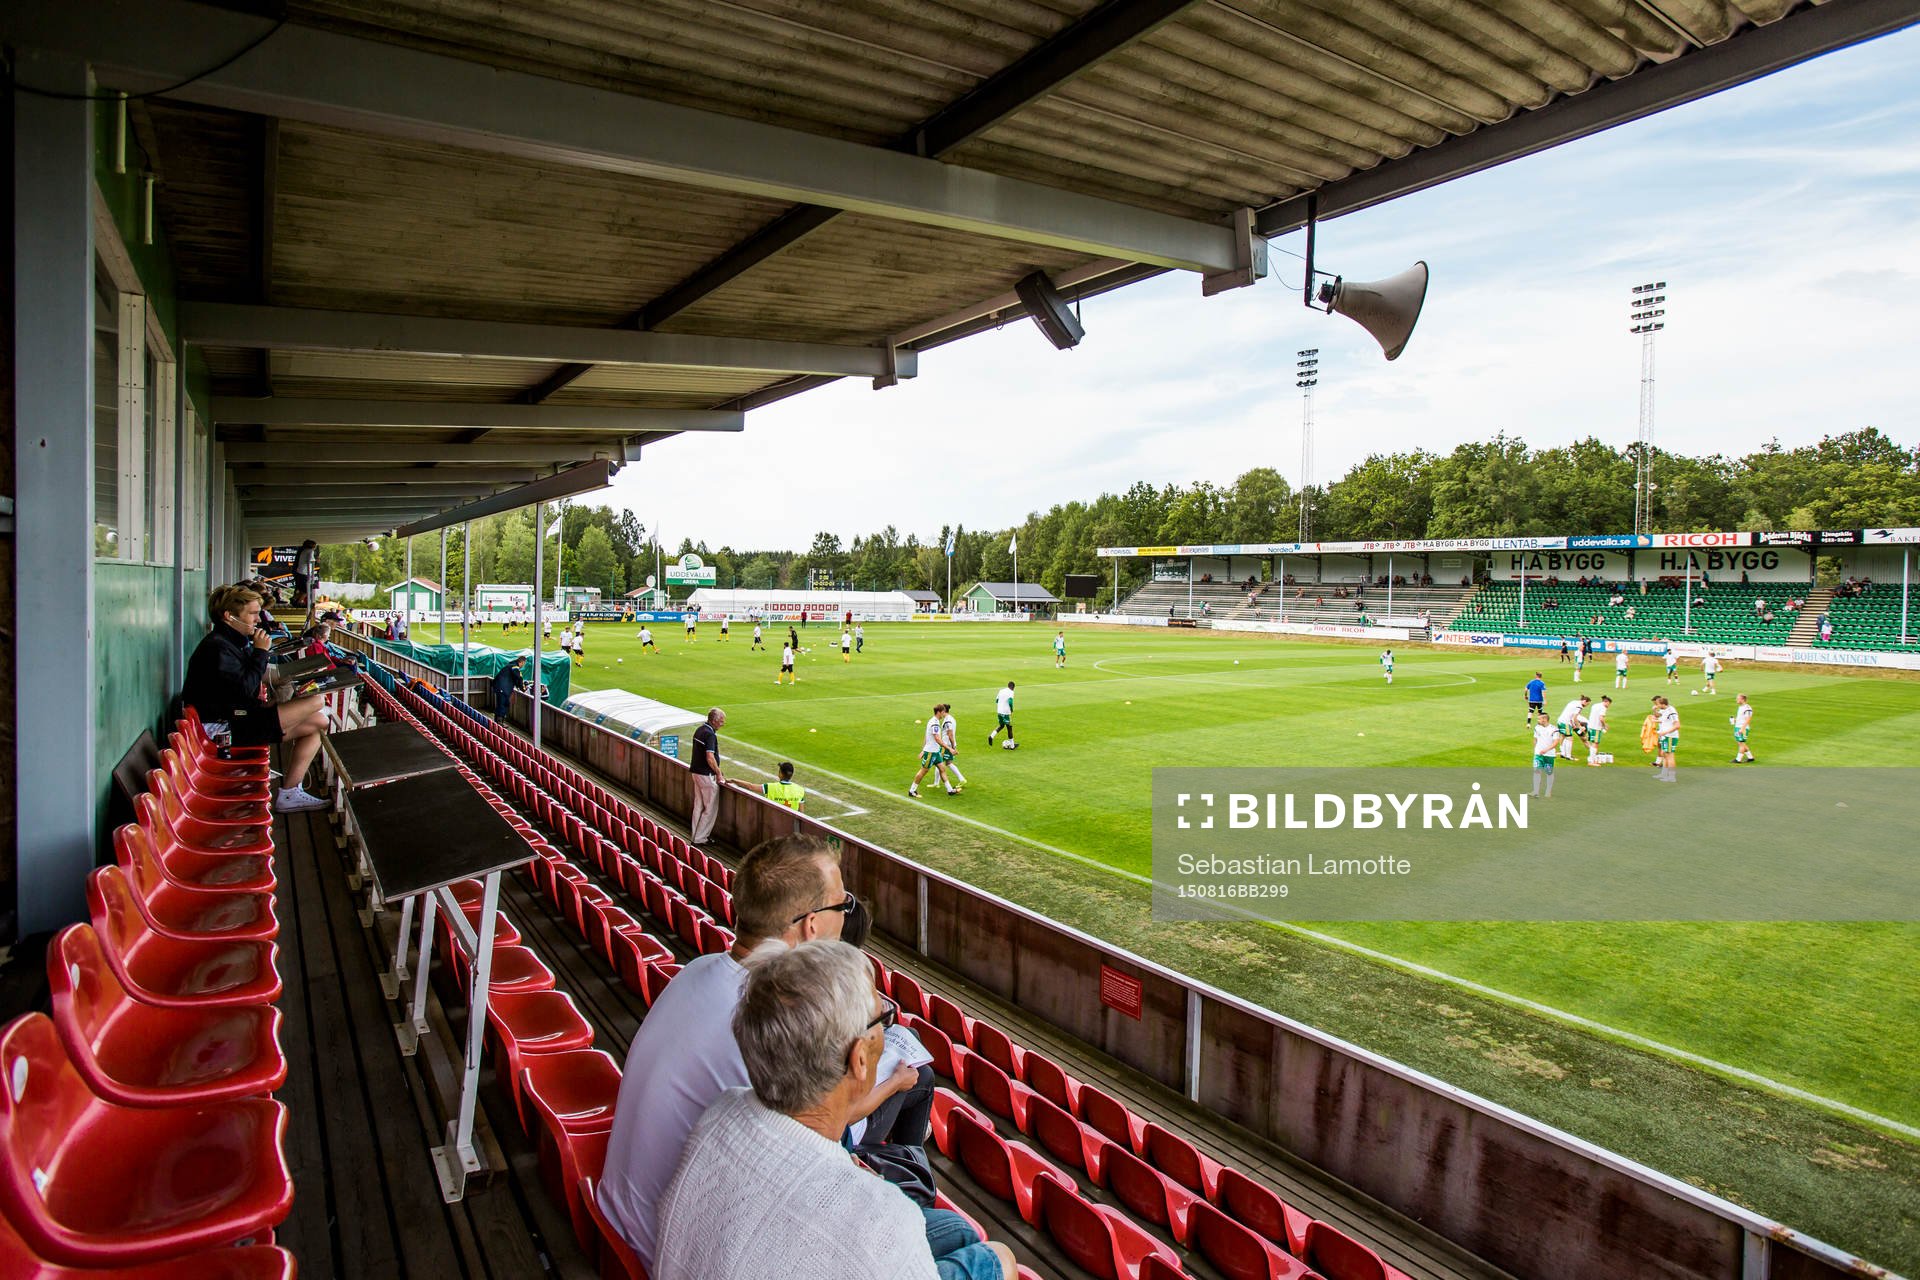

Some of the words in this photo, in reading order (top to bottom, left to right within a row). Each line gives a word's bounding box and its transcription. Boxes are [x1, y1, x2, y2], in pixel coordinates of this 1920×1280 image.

[1491, 539, 1538, 549] LLENTAB
[1572, 538, 1631, 547] uddevalla.se
[1665, 534, 1738, 546] RICOH
[1511, 553, 1543, 570] H.A
[1549, 553, 1605, 570] BYGG
[1661, 552, 1700, 570] H.A
[1708, 551, 1779, 570] BYGG
[360, 610, 377, 618] H.A
[1444, 634, 1500, 645] INTERSPORT
